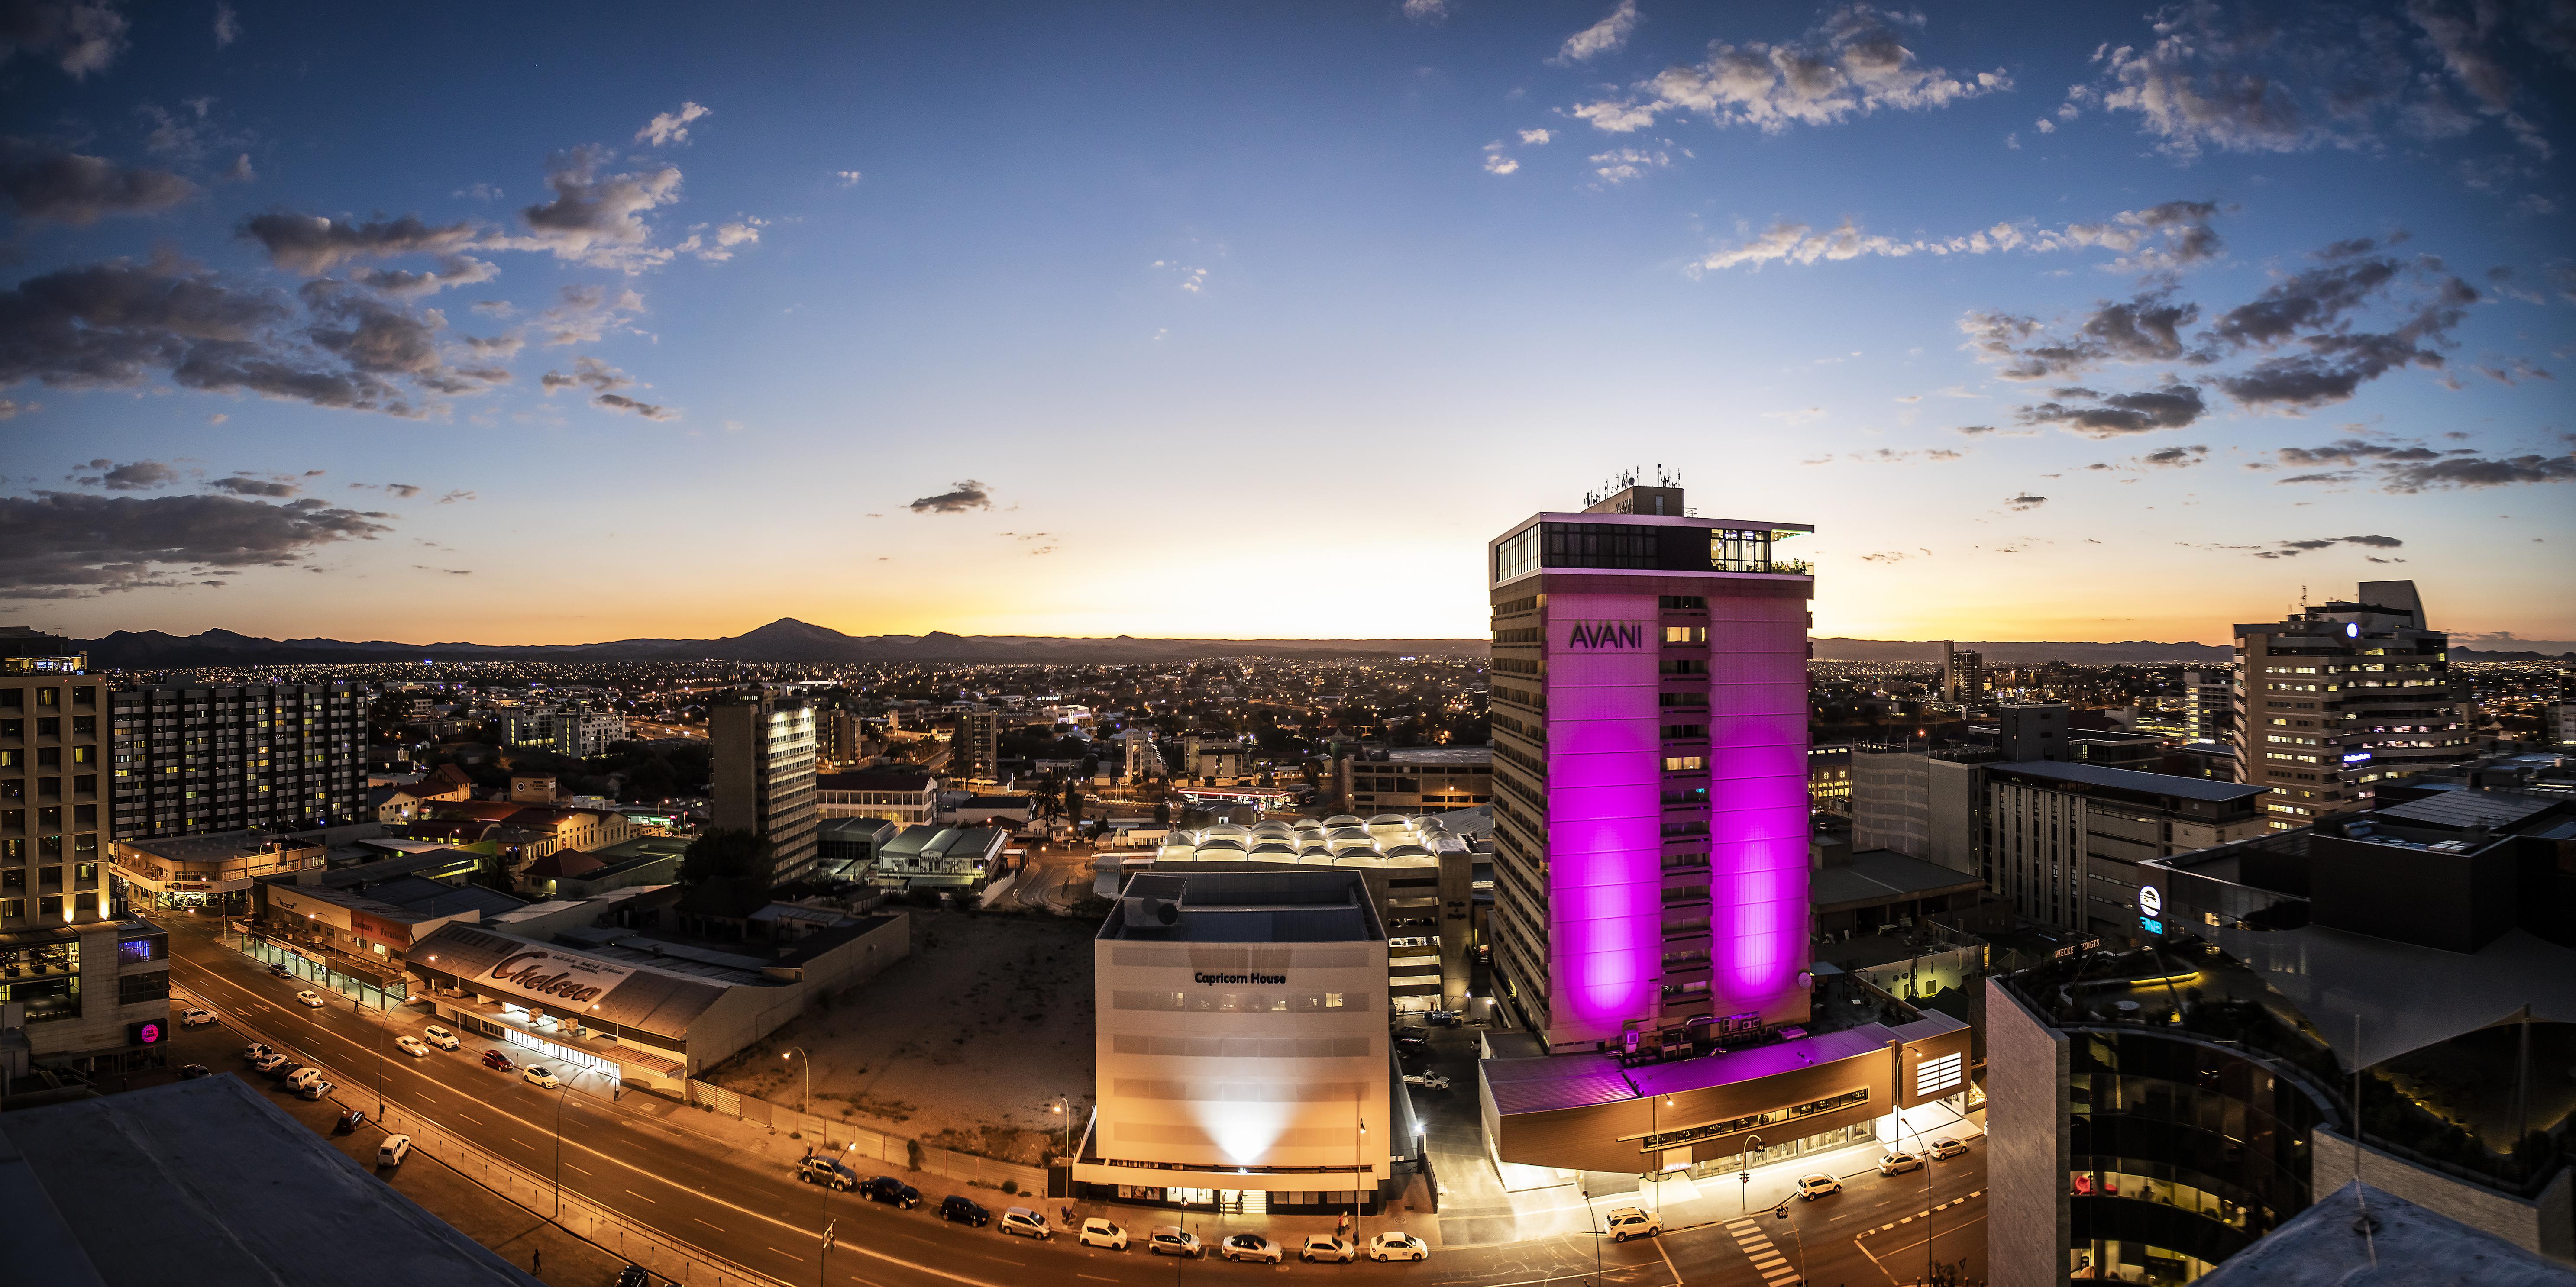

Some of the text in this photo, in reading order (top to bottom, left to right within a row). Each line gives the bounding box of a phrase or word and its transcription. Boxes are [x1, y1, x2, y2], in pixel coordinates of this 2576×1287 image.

[1570, 623, 1641, 648] AVANI
[352, 917, 373, 932] Hardware
[2139, 916, 2162, 935] FNB
[381, 926, 405, 942] Furniture
[491, 952, 602, 1002] Chelsea
[1195, 972, 1285, 986] Capricorn House
